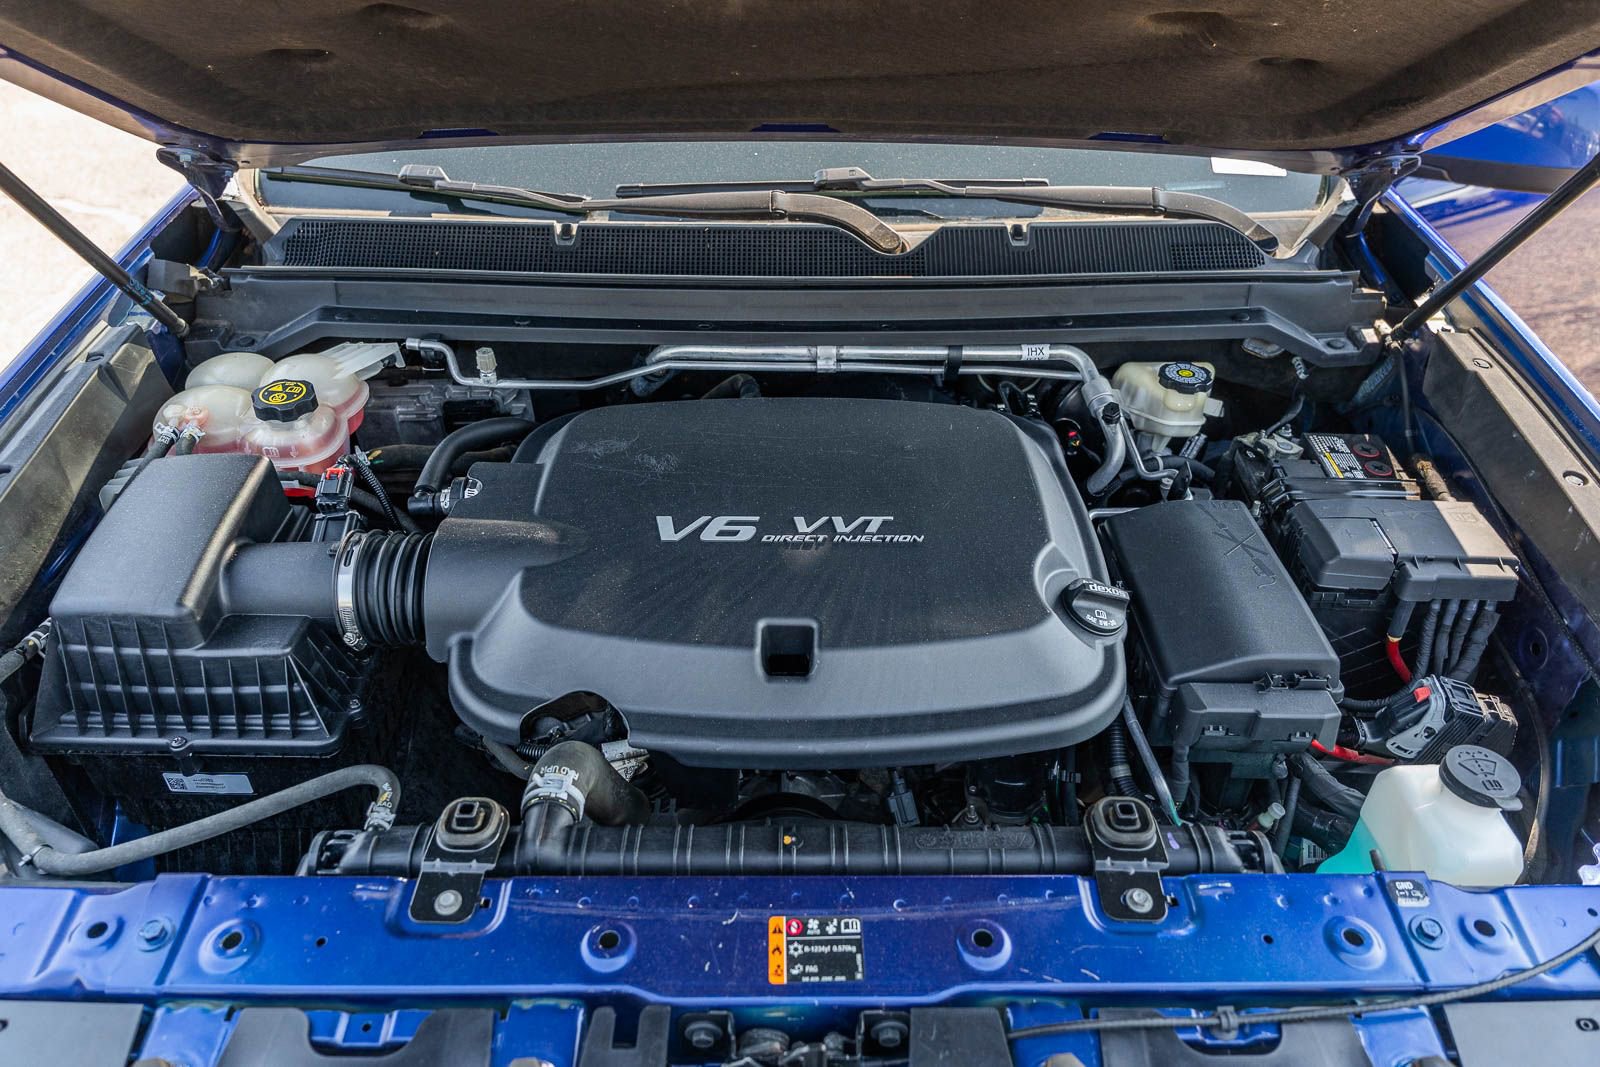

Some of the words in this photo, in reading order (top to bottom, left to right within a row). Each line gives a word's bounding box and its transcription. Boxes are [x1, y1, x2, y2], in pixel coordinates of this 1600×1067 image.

[1027, 347, 1045, 356] IHX
[655, 515, 760, 542] V6
[793, 516, 894, 534] VVT
[761, 534, 828, 542] DIRECT
[833, 534, 925, 543] INJECTION
